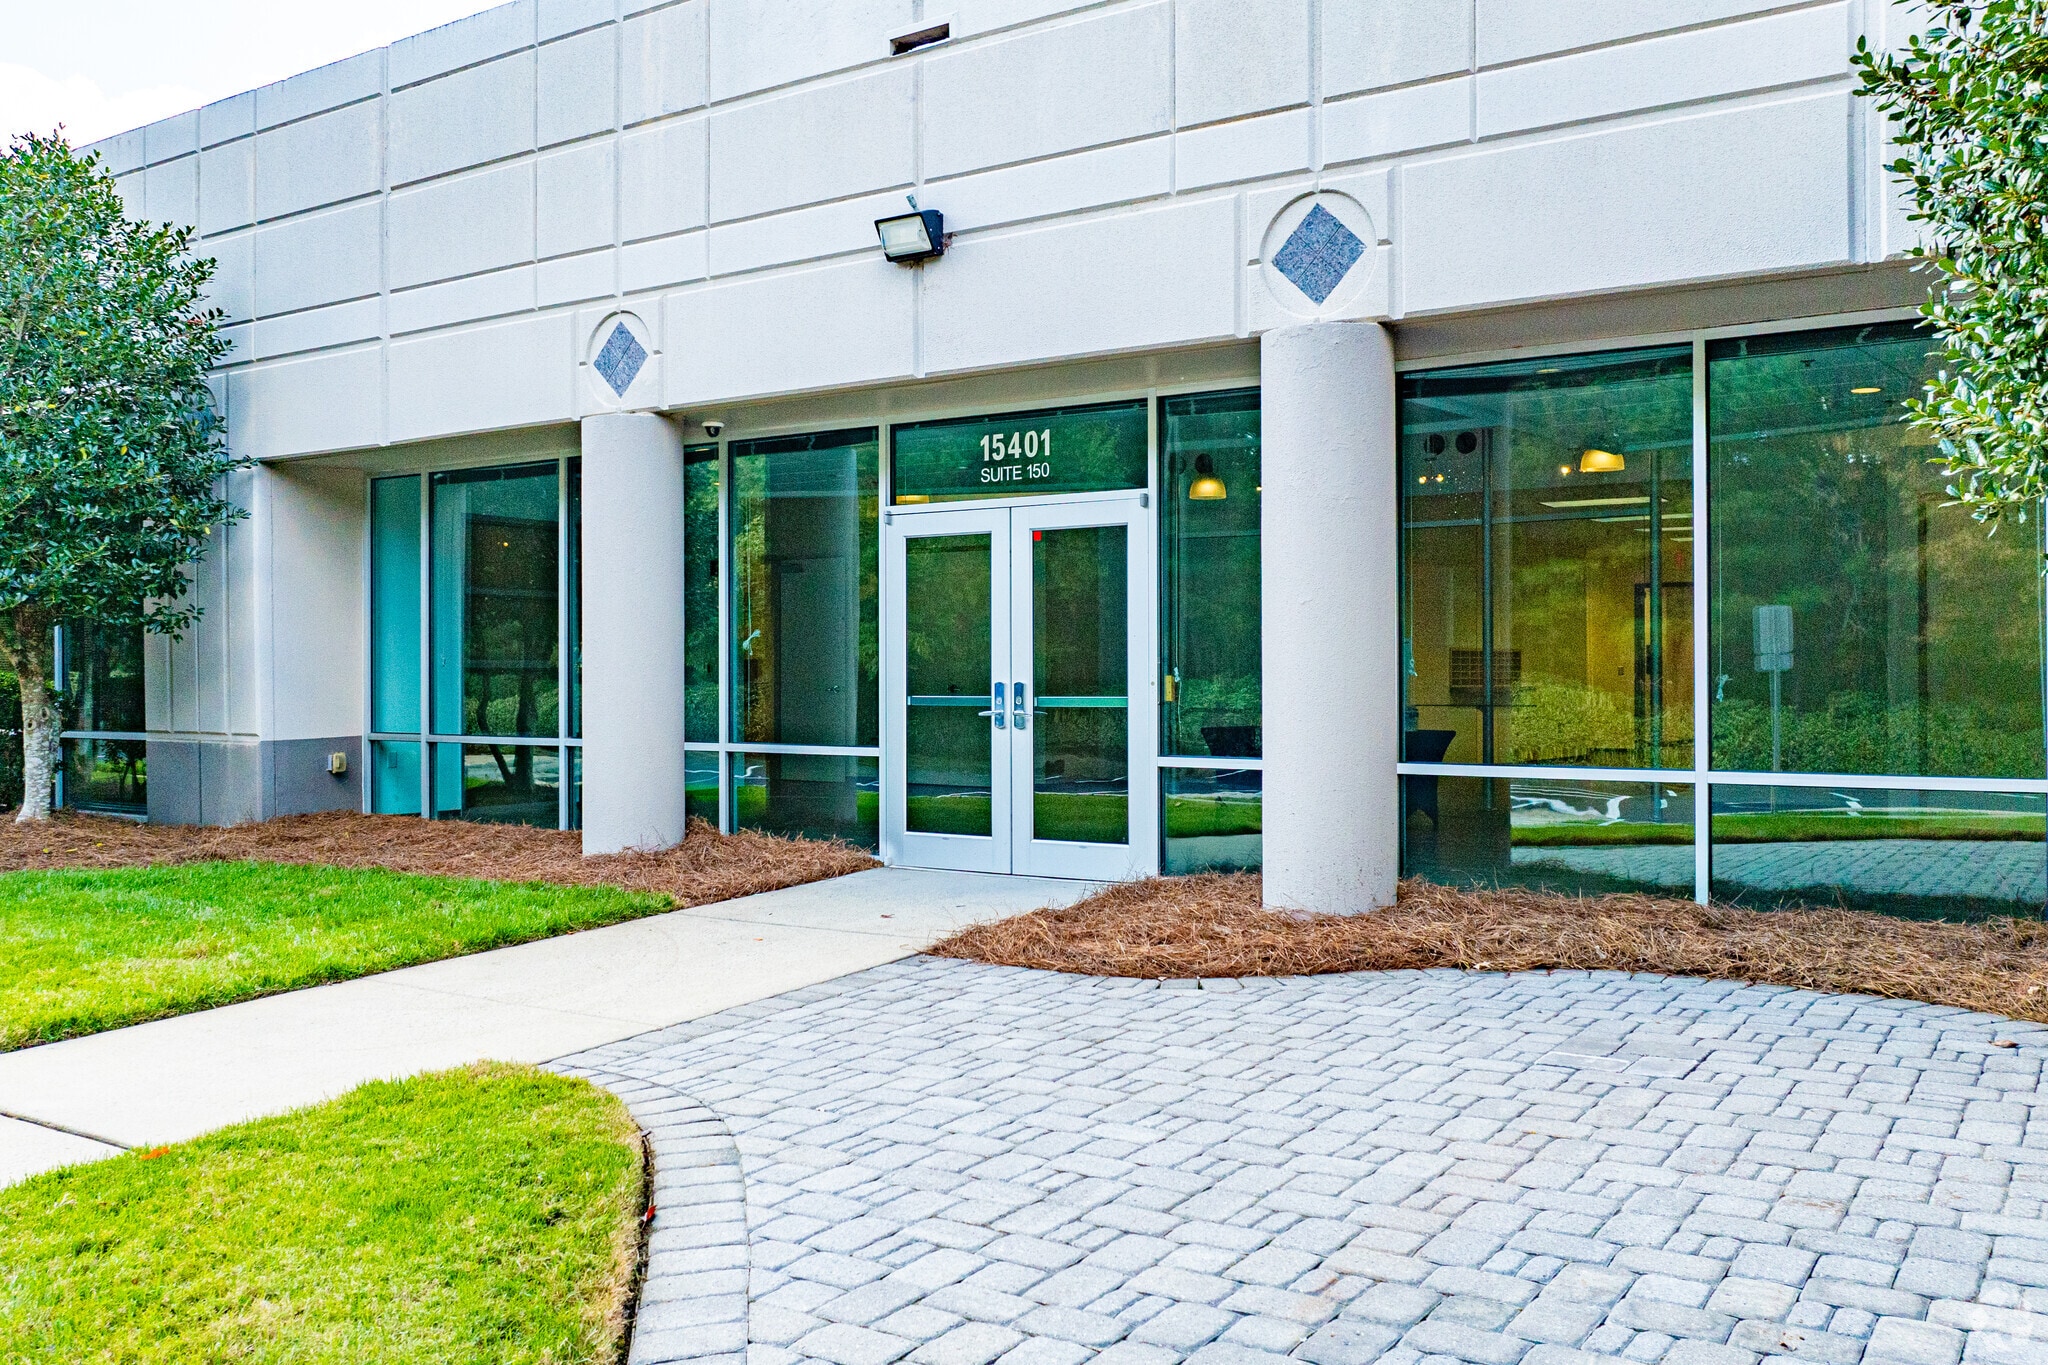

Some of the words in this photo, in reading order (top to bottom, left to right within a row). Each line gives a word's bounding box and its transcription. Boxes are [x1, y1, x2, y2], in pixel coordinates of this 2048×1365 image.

[980, 429, 1050, 461] 15401
[980, 465, 1022, 483] SUITE
[1026, 462, 1050, 479] 150
